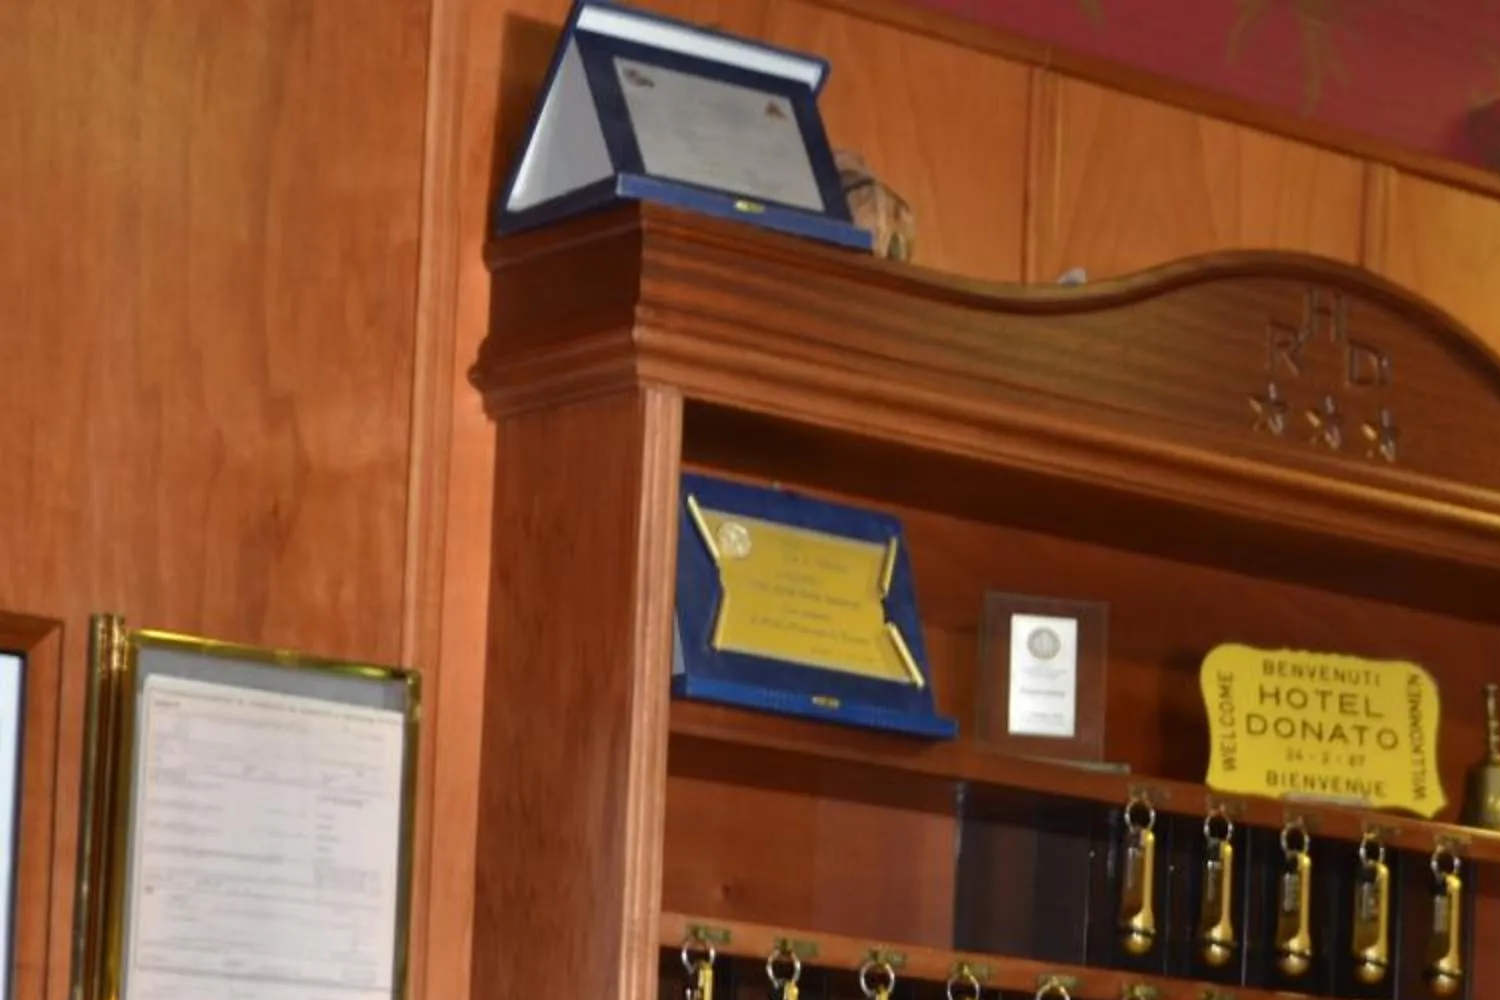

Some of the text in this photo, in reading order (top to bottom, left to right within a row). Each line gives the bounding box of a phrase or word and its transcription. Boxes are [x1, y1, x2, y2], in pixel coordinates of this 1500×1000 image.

[1262, 658, 1381, 688] BENVENUTI
[1257, 684, 1386, 718] HOTEL
[1215, 669, 1238, 772] WELCOME
[1246, 713, 1399, 751] DONATO
[1266, 770, 1387, 798] BIENVENUE
